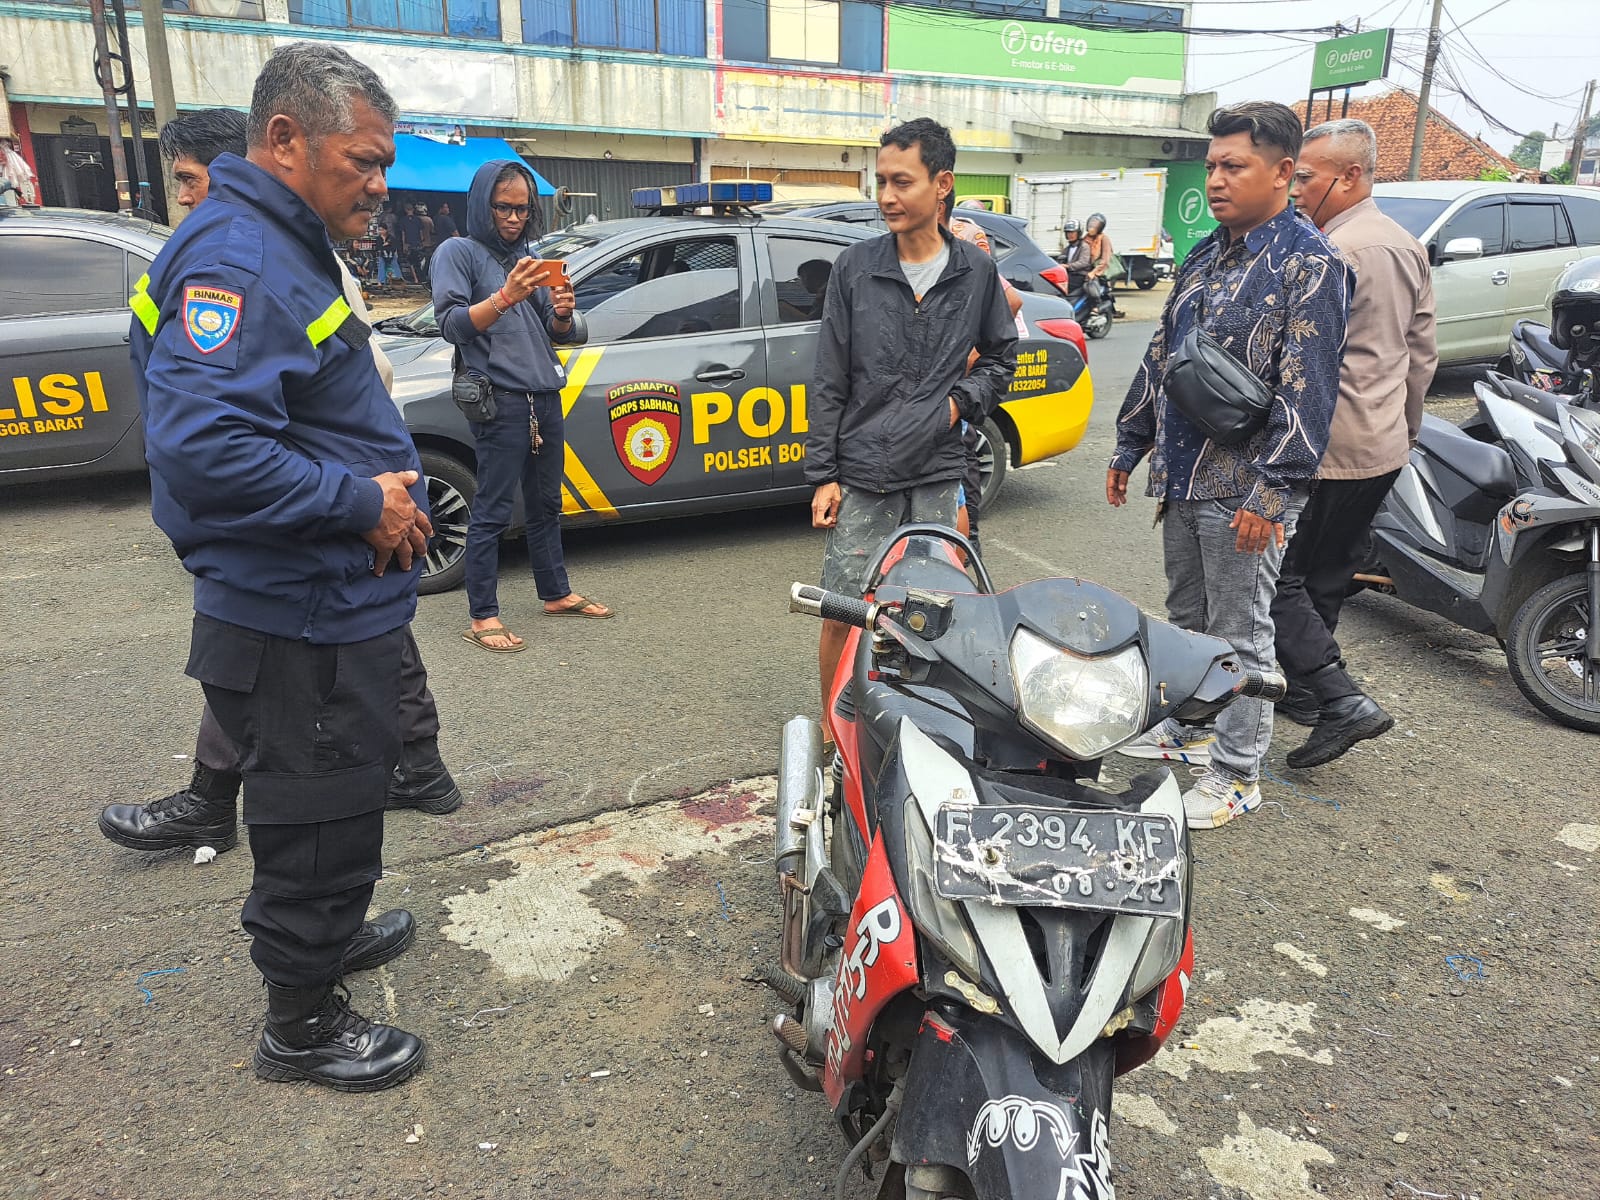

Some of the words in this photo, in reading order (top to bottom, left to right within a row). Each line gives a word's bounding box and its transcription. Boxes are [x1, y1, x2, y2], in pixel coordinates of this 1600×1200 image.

[1029, 31, 1088, 55] ofero
[1011, 58, 1043, 69] E-motor
[1340, 48, 1373, 63] ofero
[193, 290, 233, 304] BINMAS
[1016, 352, 1035, 364] enter
[1036, 350, 1047, 362] 110
[1028, 365, 1047, 376] BARAT
[609, 382, 677, 400] DITSAMAPTA
[1013, 379, 1045, 391] 8322054
[0, 371, 109, 420] ISI
[610, 401, 638, 421] KORPS
[639, 399, 680, 415] SABHARA
[691, 384, 809, 445] POL
[0, 422, 31, 437] GOR
[34, 417, 84, 433] BARAT
[703, 446, 773, 473] POLSEK
[778, 442, 807, 463] BO
[946, 811, 969, 845] F
[991, 812, 1091, 850] 2394
[1115, 818, 1166, 858] KF
